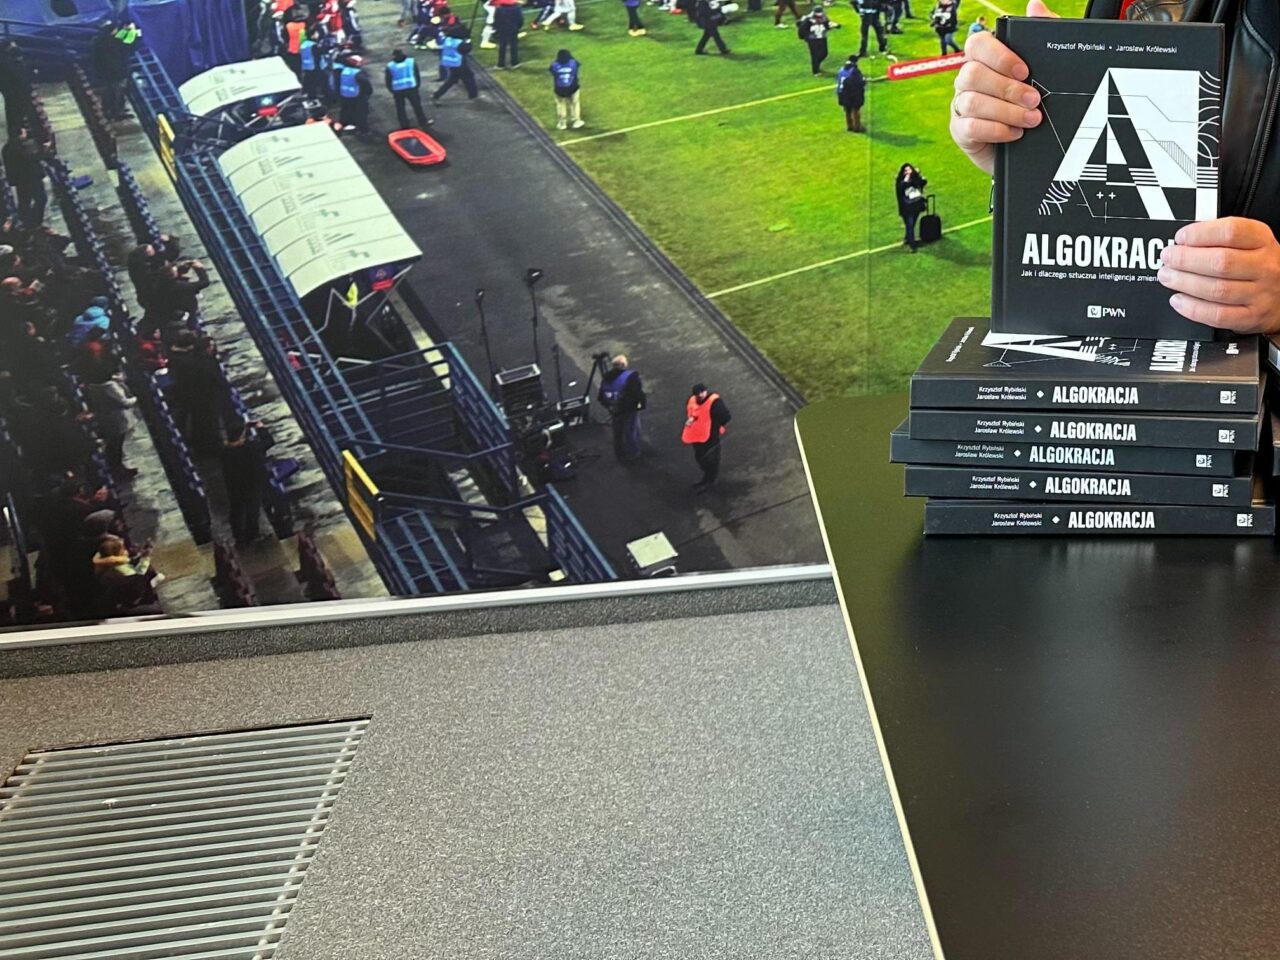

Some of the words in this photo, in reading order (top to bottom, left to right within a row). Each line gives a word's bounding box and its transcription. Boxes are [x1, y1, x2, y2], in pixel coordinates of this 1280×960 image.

[1046, 41, 1076, 51] Krzysztof
[1021, 232, 1176, 271] ALGOKRAC
[1021, 269, 1033, 277] Jak
[1038, 270, 1067, 280] dlaczego
[1068, 271, 1097, 280] sztuczna
[1098, 272, 1136, 283] inteligencja
[1102, 307, 1126, 318] PWN
[1052, 385, 1139, 405] ALGOKRACJA
[1050, 421, 1137, 441] ALGOKRACJA
[1029, 445, 1115, 466] ALGOKRACJA
[1044, 476, 1132, 496] ALGOKRACJA
[1068, 511, 1156, 529] ALGOKRACJA
